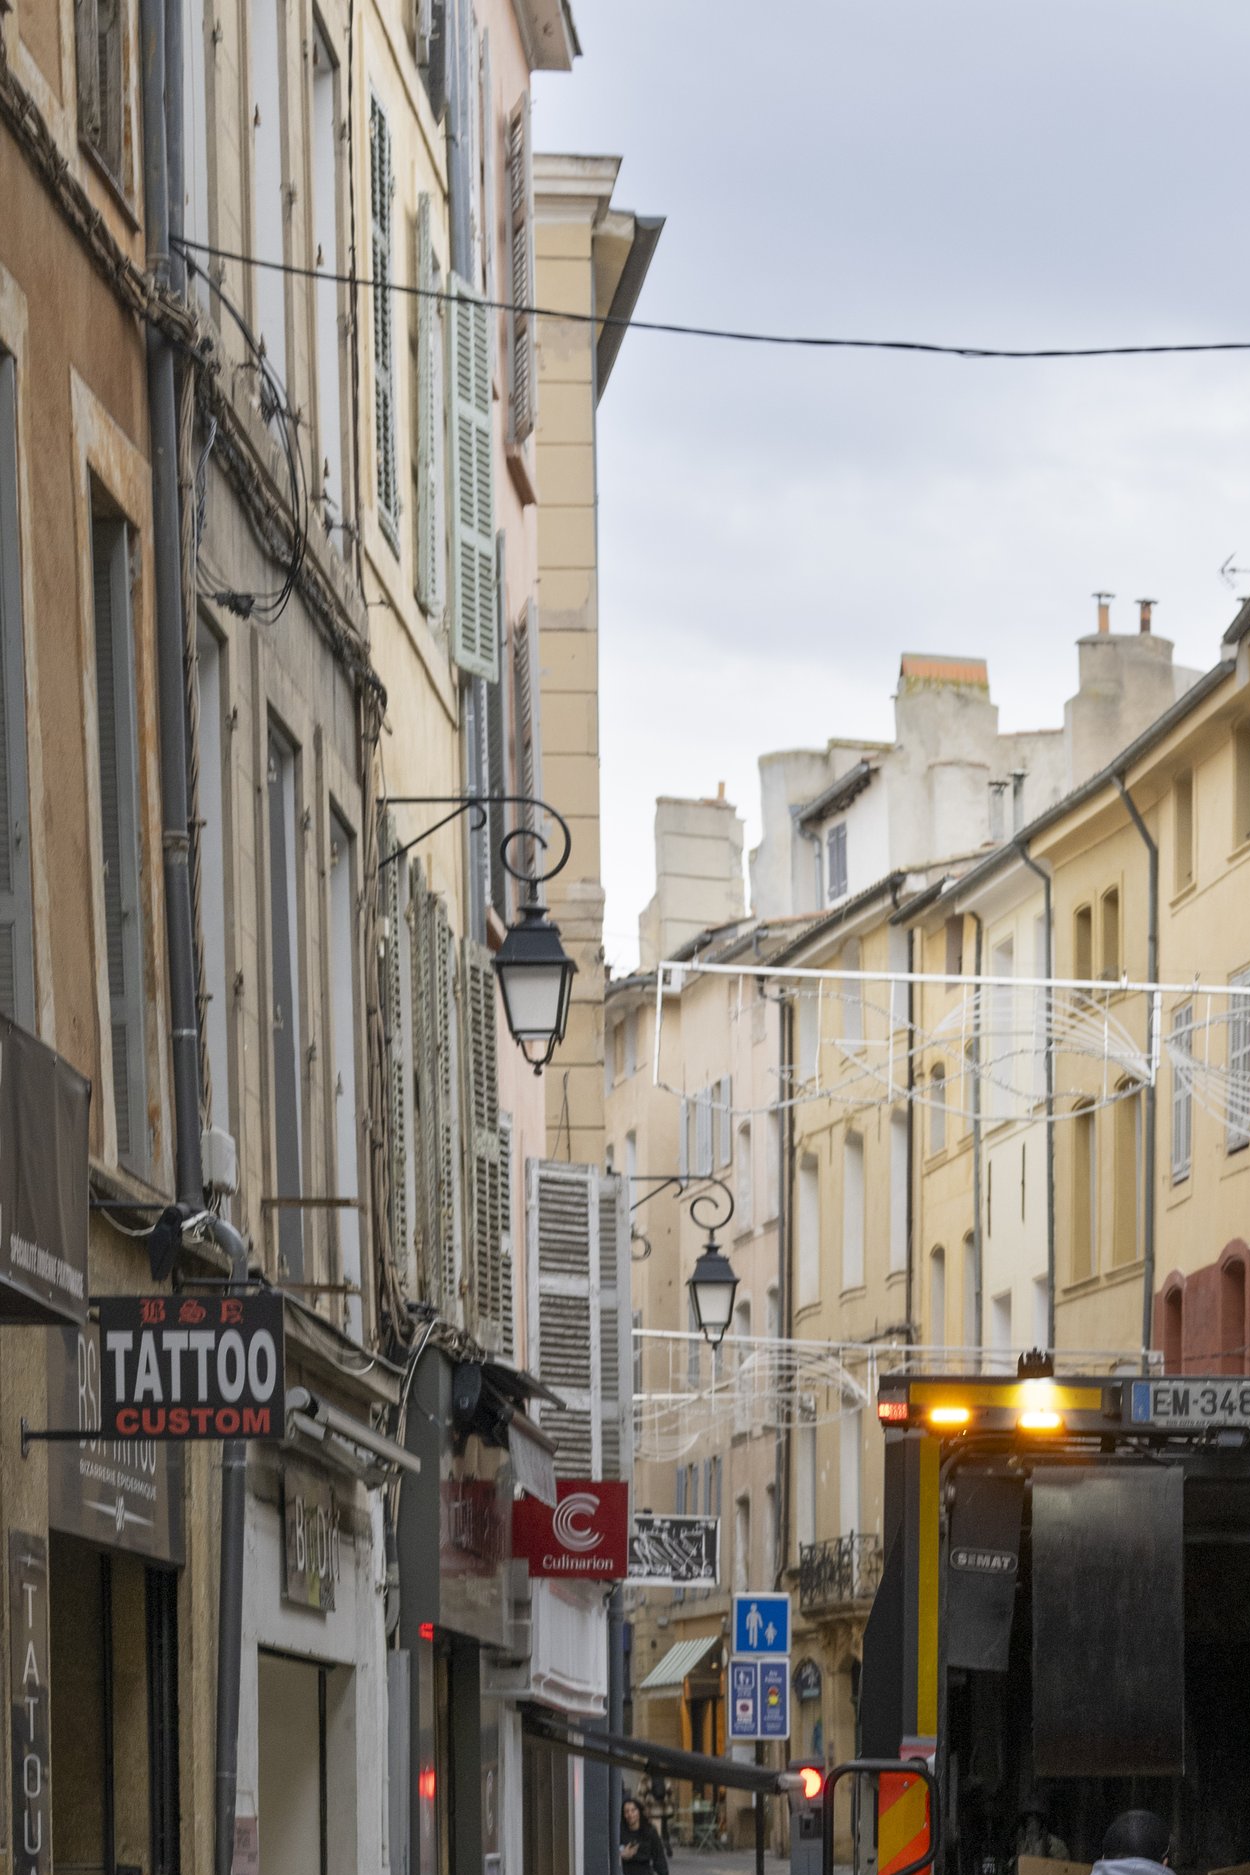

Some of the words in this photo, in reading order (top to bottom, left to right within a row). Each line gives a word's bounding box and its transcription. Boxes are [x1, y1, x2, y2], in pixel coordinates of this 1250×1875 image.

[106, 1328, 277, 1403] TATTOO
[115, 1407, 271, 1435] CUSTOM
[542, 1554, 614, 1571] Culinarion
[957, 1552, 1012, 1571] SEMAT
